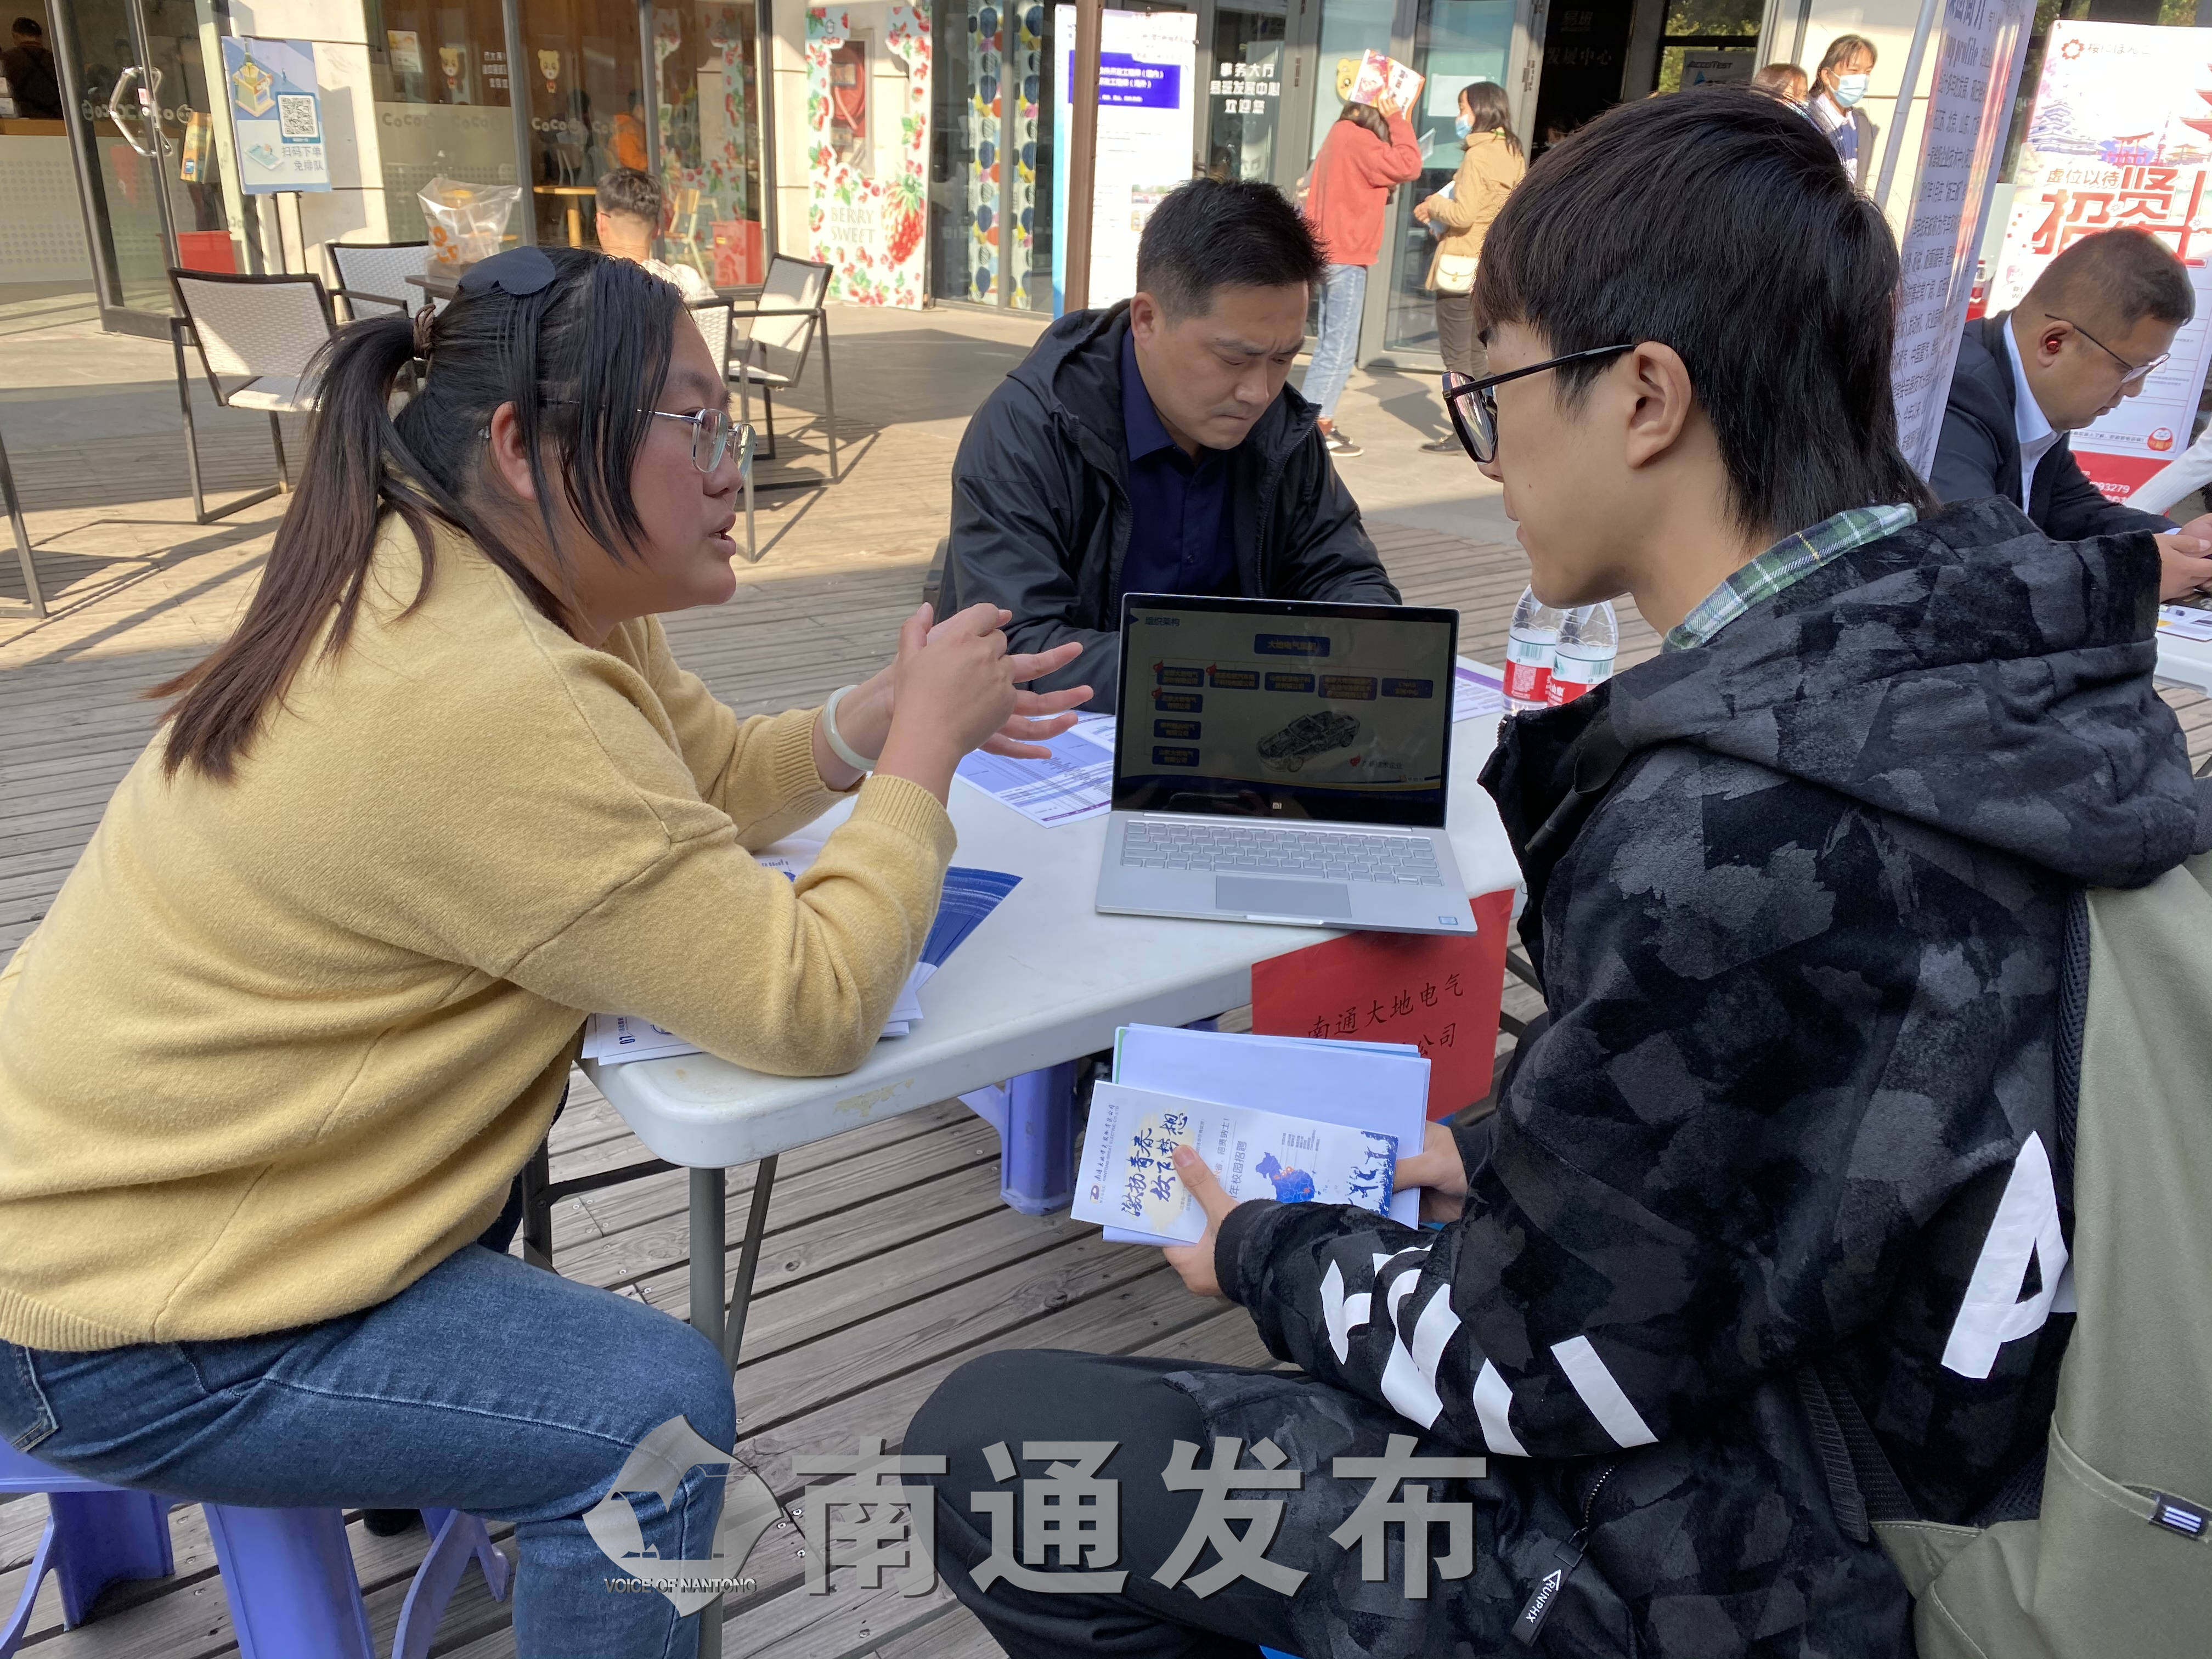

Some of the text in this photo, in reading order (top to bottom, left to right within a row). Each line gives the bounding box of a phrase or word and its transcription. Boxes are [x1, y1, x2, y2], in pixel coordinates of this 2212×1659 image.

[281, 145, 321, 157] 扫码下单
[294, 159, 324, 171] 免排队
[2047, 168, 2121, 188] 虚位以待
[831, 206, 875, 224] BERRY
[831, 225, 876, 243] SWEET
[1308, 973, 1463, 1039] 南通大地电气
[1150, 1113, 1188, 1202] 放飞梦想
[1121, 1127, 1154, 1217] 激扬青春
[1526, 1579, 1556, 1623] RUNPHX
